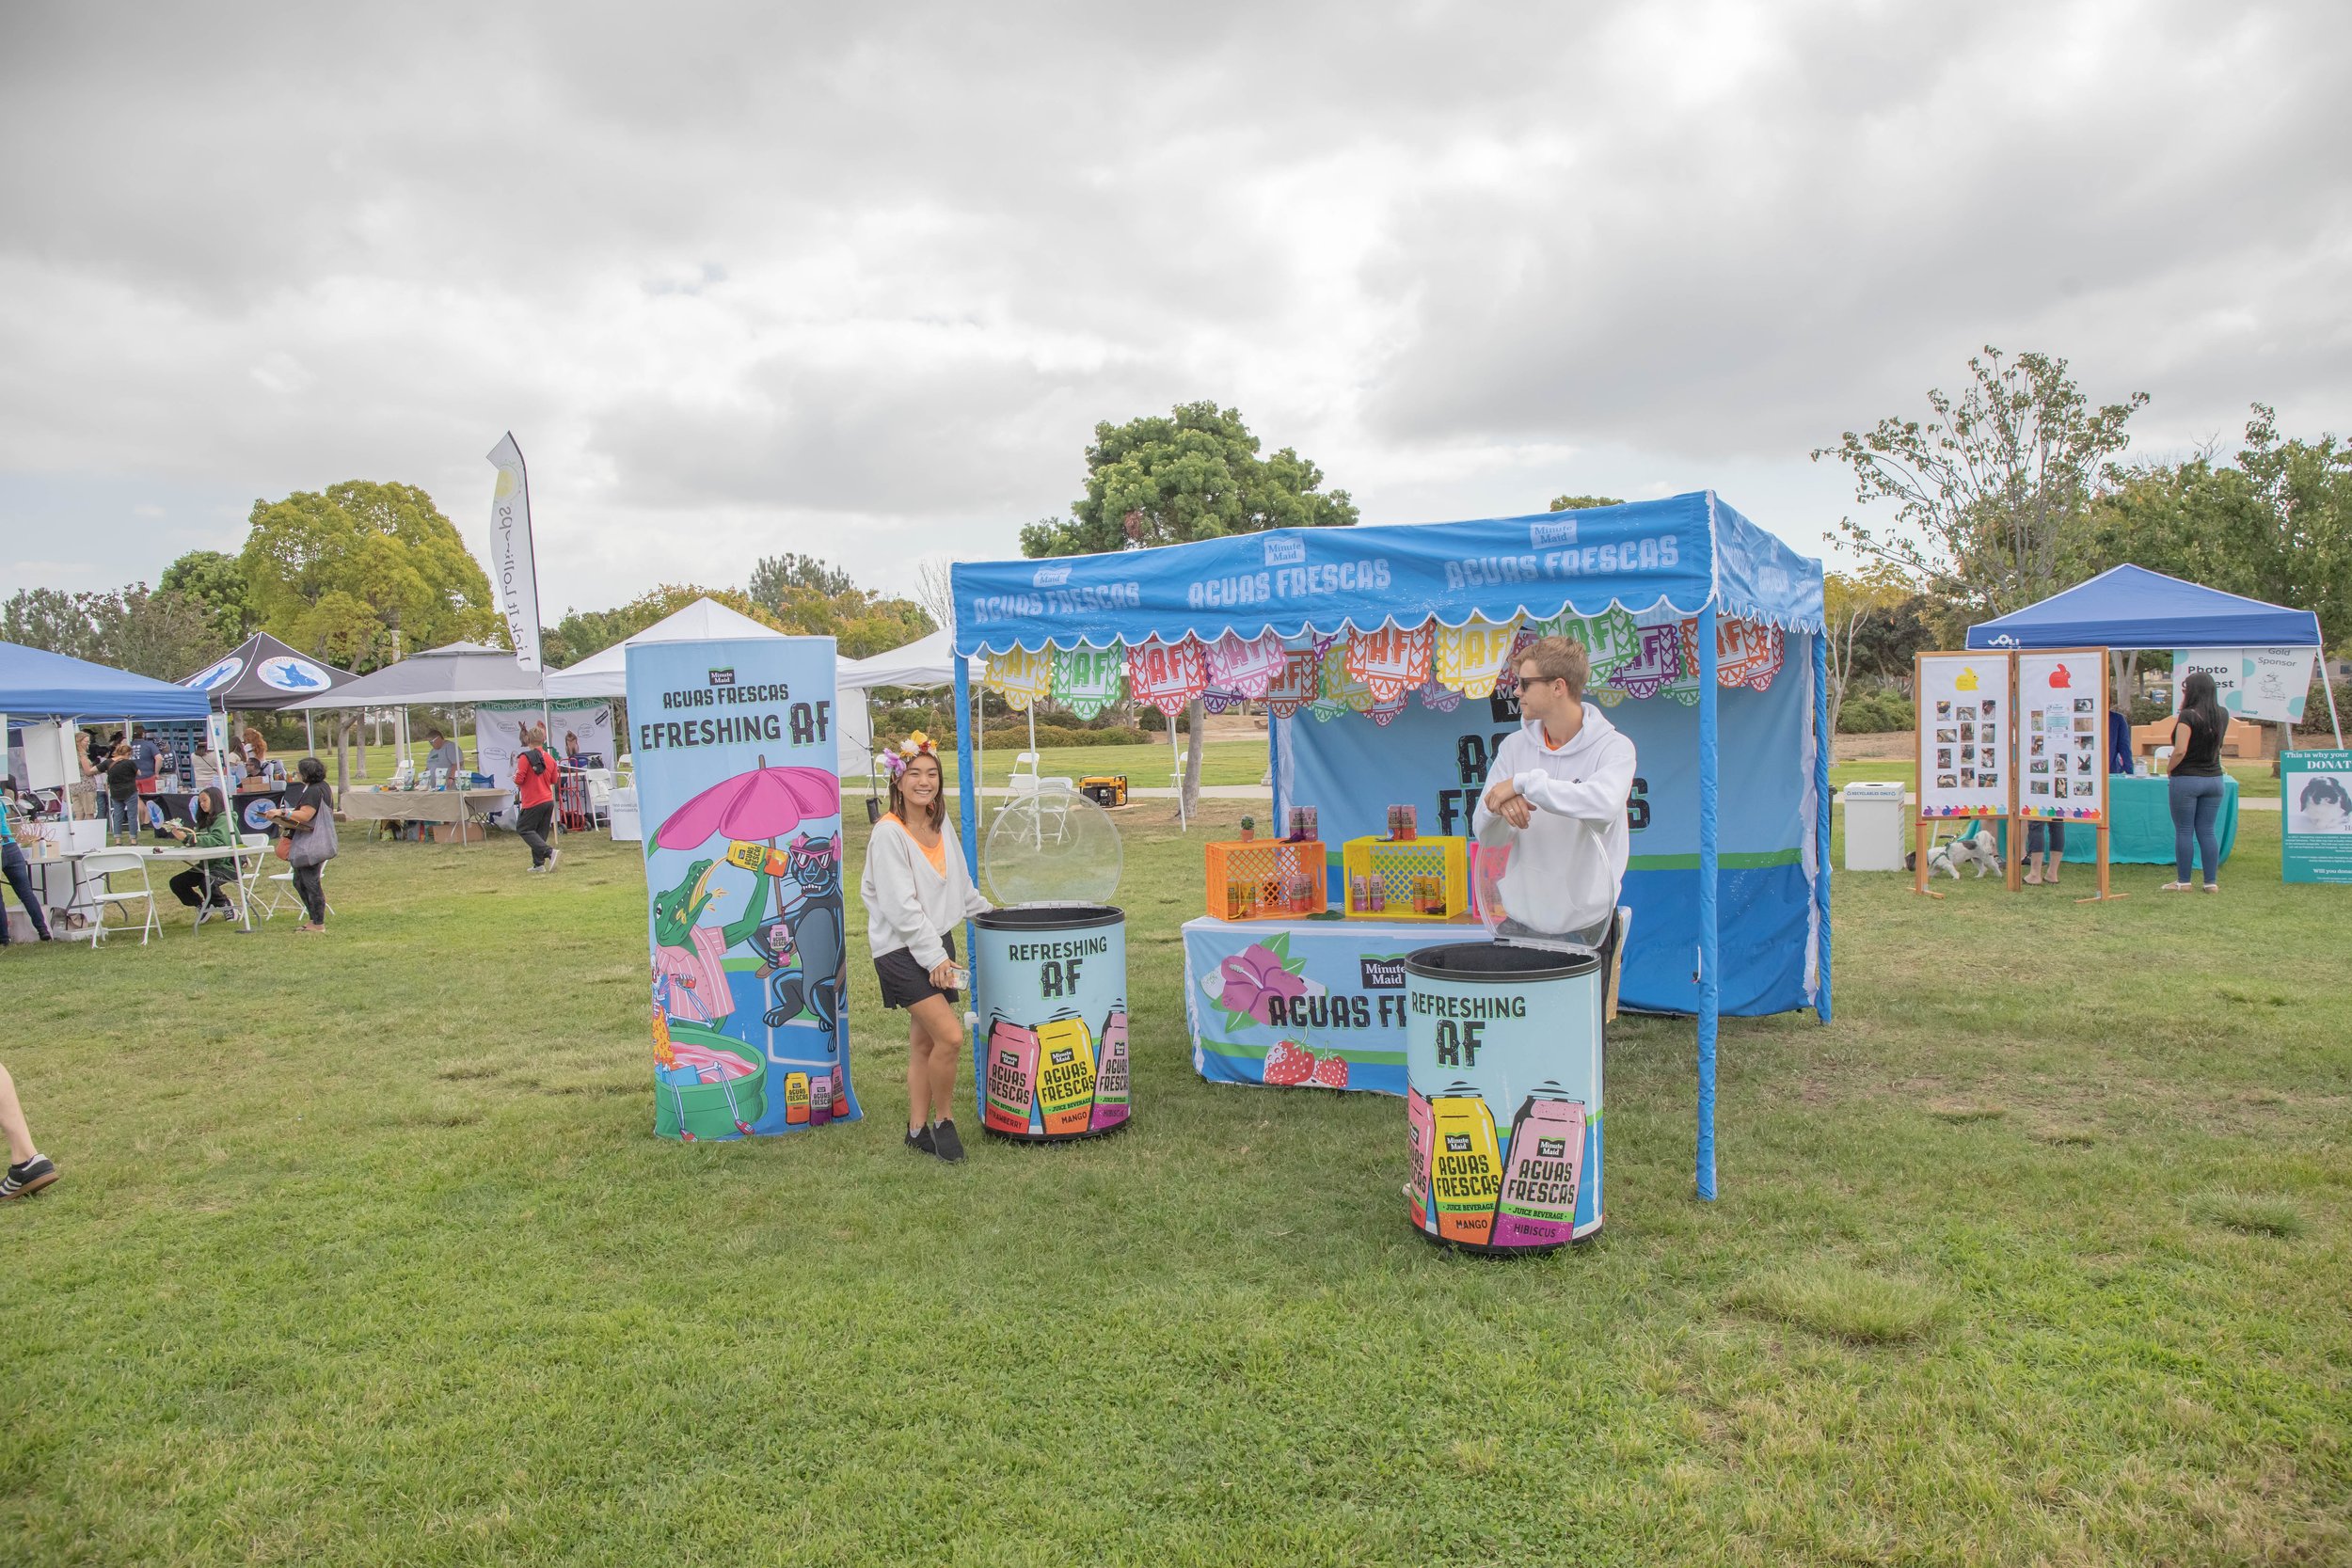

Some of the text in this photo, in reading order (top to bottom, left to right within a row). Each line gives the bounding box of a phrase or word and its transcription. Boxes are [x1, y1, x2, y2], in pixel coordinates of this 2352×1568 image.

[1534, 524, 1573, 535] Minute
[1540, 532, 1567, 544] Maid
[1268, 542, 1302, 553] Minute
[1273, 551, 1297, 562] Maid
[1444, 555, 1539, 592] AGUAS
[1544, 534, 1679, 579] FRESCAS
[1040, 576, 1060, 584] Maid
[1188, 559, 1391, 609] AGUAS FRESCAS
[973, 581, 1141, 625] AGUAS FRESCAS
[1366, 628, 1411, 667] AF
[1461, 628, 1508, 670] AF
[2268, 647, 2291, 657] Gold
[1072, 652, 1109, 688] AF
[1147, 646, 1184, 686] AF
[2258, 657, 2297, 668] Sponsor
[663, 684, 789, 708] AGUAS FRESCAS
[640, 701, 831, 751] EFRESHING AF
[1009, 936, 1106, 961] REFRESHING
[1041, 958, 1083, 997] AF
[1365, 963, 1406, 974] Minute
[1372, 974, 1403, 985] Maid
[1269, 995, 1371, 1028] AGUAS
[1412, 990, 1526, 1019] REFRESHING
[1436, 1019, 1486, 1067] AF
[1052, 1051, 1072, 1060] Minute
[1056, 1055, 1071, 1064] Maid
[993, 1064, 1026, 1087] AGUAS
[1044, 1061, 1088, 1085] AGUAS
[989, 1077, 1030, 1105] FRESCAS
[1041, 1075, 1095, 1103] FRESCAS
[1068, 1098, 1092, 1110] BEVERAGE
[1061, 1111, 1088, 1124] MANGO
[1540, 1141, 1564, 1149] Minute
[1411, 1146, 1424, 1172] UAS
[1438, 1154, 1489, 1176] AGUAS
[1518, 1159, 1573, 1181] AGUAS
[1436, 1175, 1501, 1197] FRESCAS
[1507, 1179, 1575, 1205] FRESCAS
[1455, 1220, 1488, 1229] MANGO
[1513, 1207, 1564, 1220] JUICE BEVERAGE
[1514, 1223, 1557, 1238] HIBISCUS
